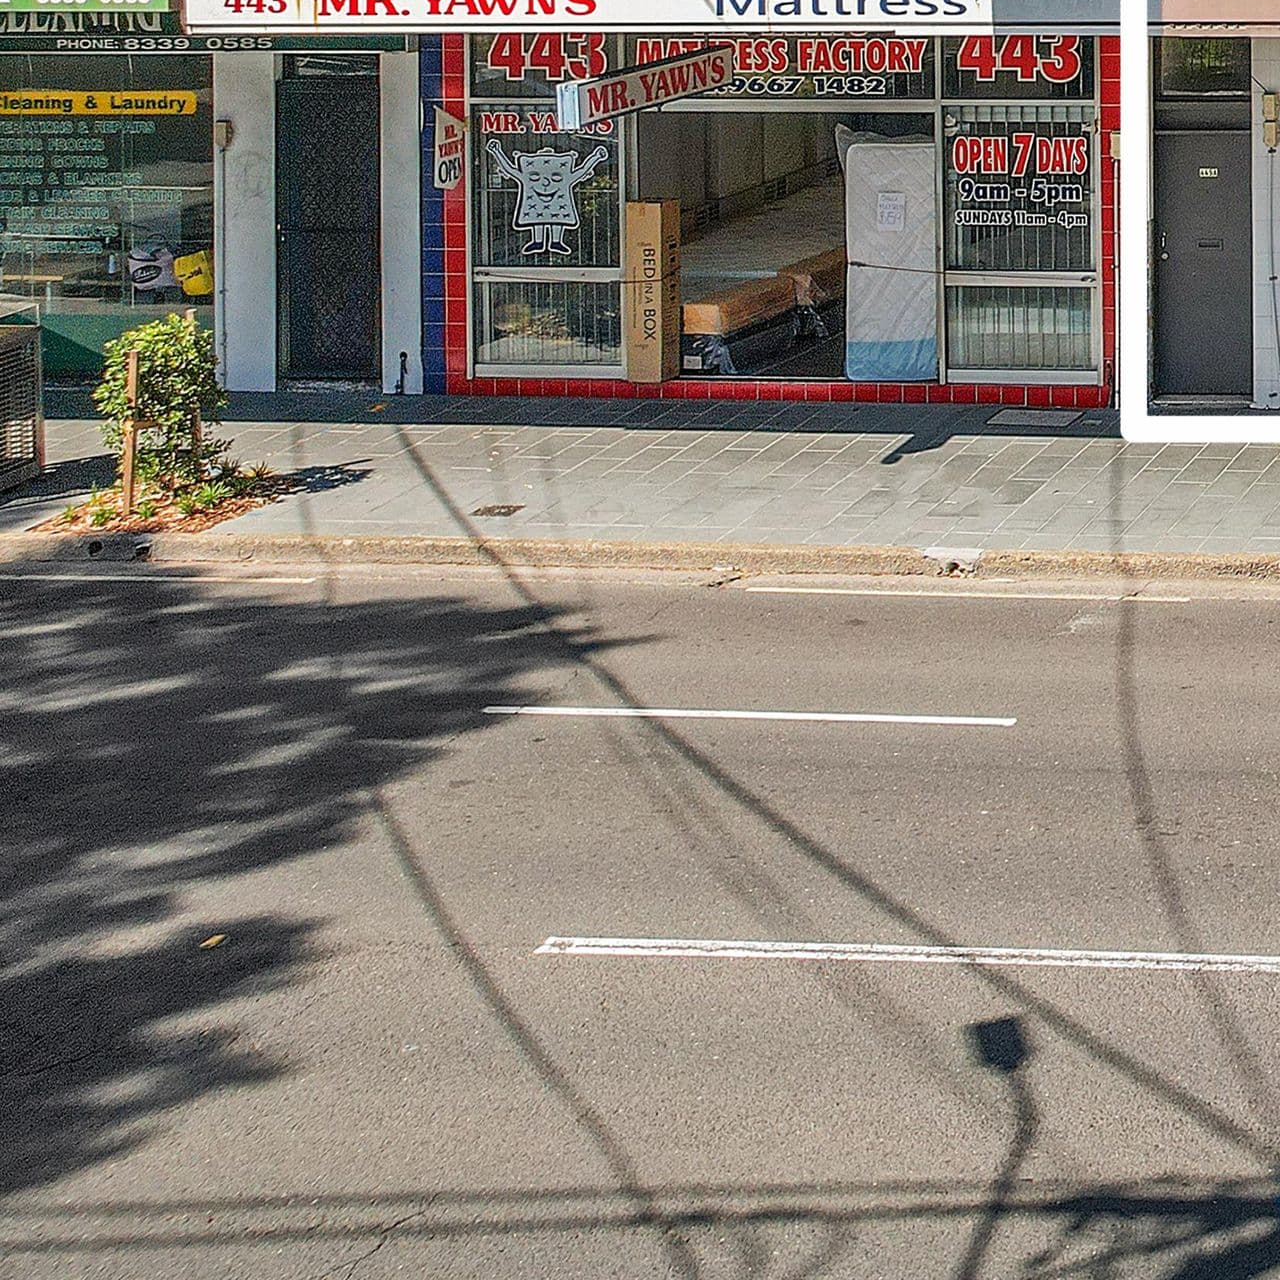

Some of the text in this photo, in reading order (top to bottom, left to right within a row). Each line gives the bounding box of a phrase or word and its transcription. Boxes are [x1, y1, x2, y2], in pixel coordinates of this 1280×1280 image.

[56, 37, 273, 51] PHONE: 8339 0585
[487, 32, 607, 81] 443
[636, 37, 927, 73] MAESS FACTORY
[957, 34, 1082, 83] 443
[586, 55, 725, 119] MR. YAWN'S
[813, 76, 886, 96] 1482
[84, 94, 99, 111] &
[110, 94, 187, 113] Laundry
[481, 112, 526, 134] MR.
[953, 133, 1088, 177] OPEN 7 DAYS
[958, 177, 1011, 202] 9am
[1030, 177, 1083, 207] 5pm
[955, 209, 1012, 226] SUNDAYS
[1014, 210, 1047, 226] 11am
[1056, 210, 1089, 229] 4pm
[642, 247, 656, 279] BED
[643, 307, 657, 341] BOX
